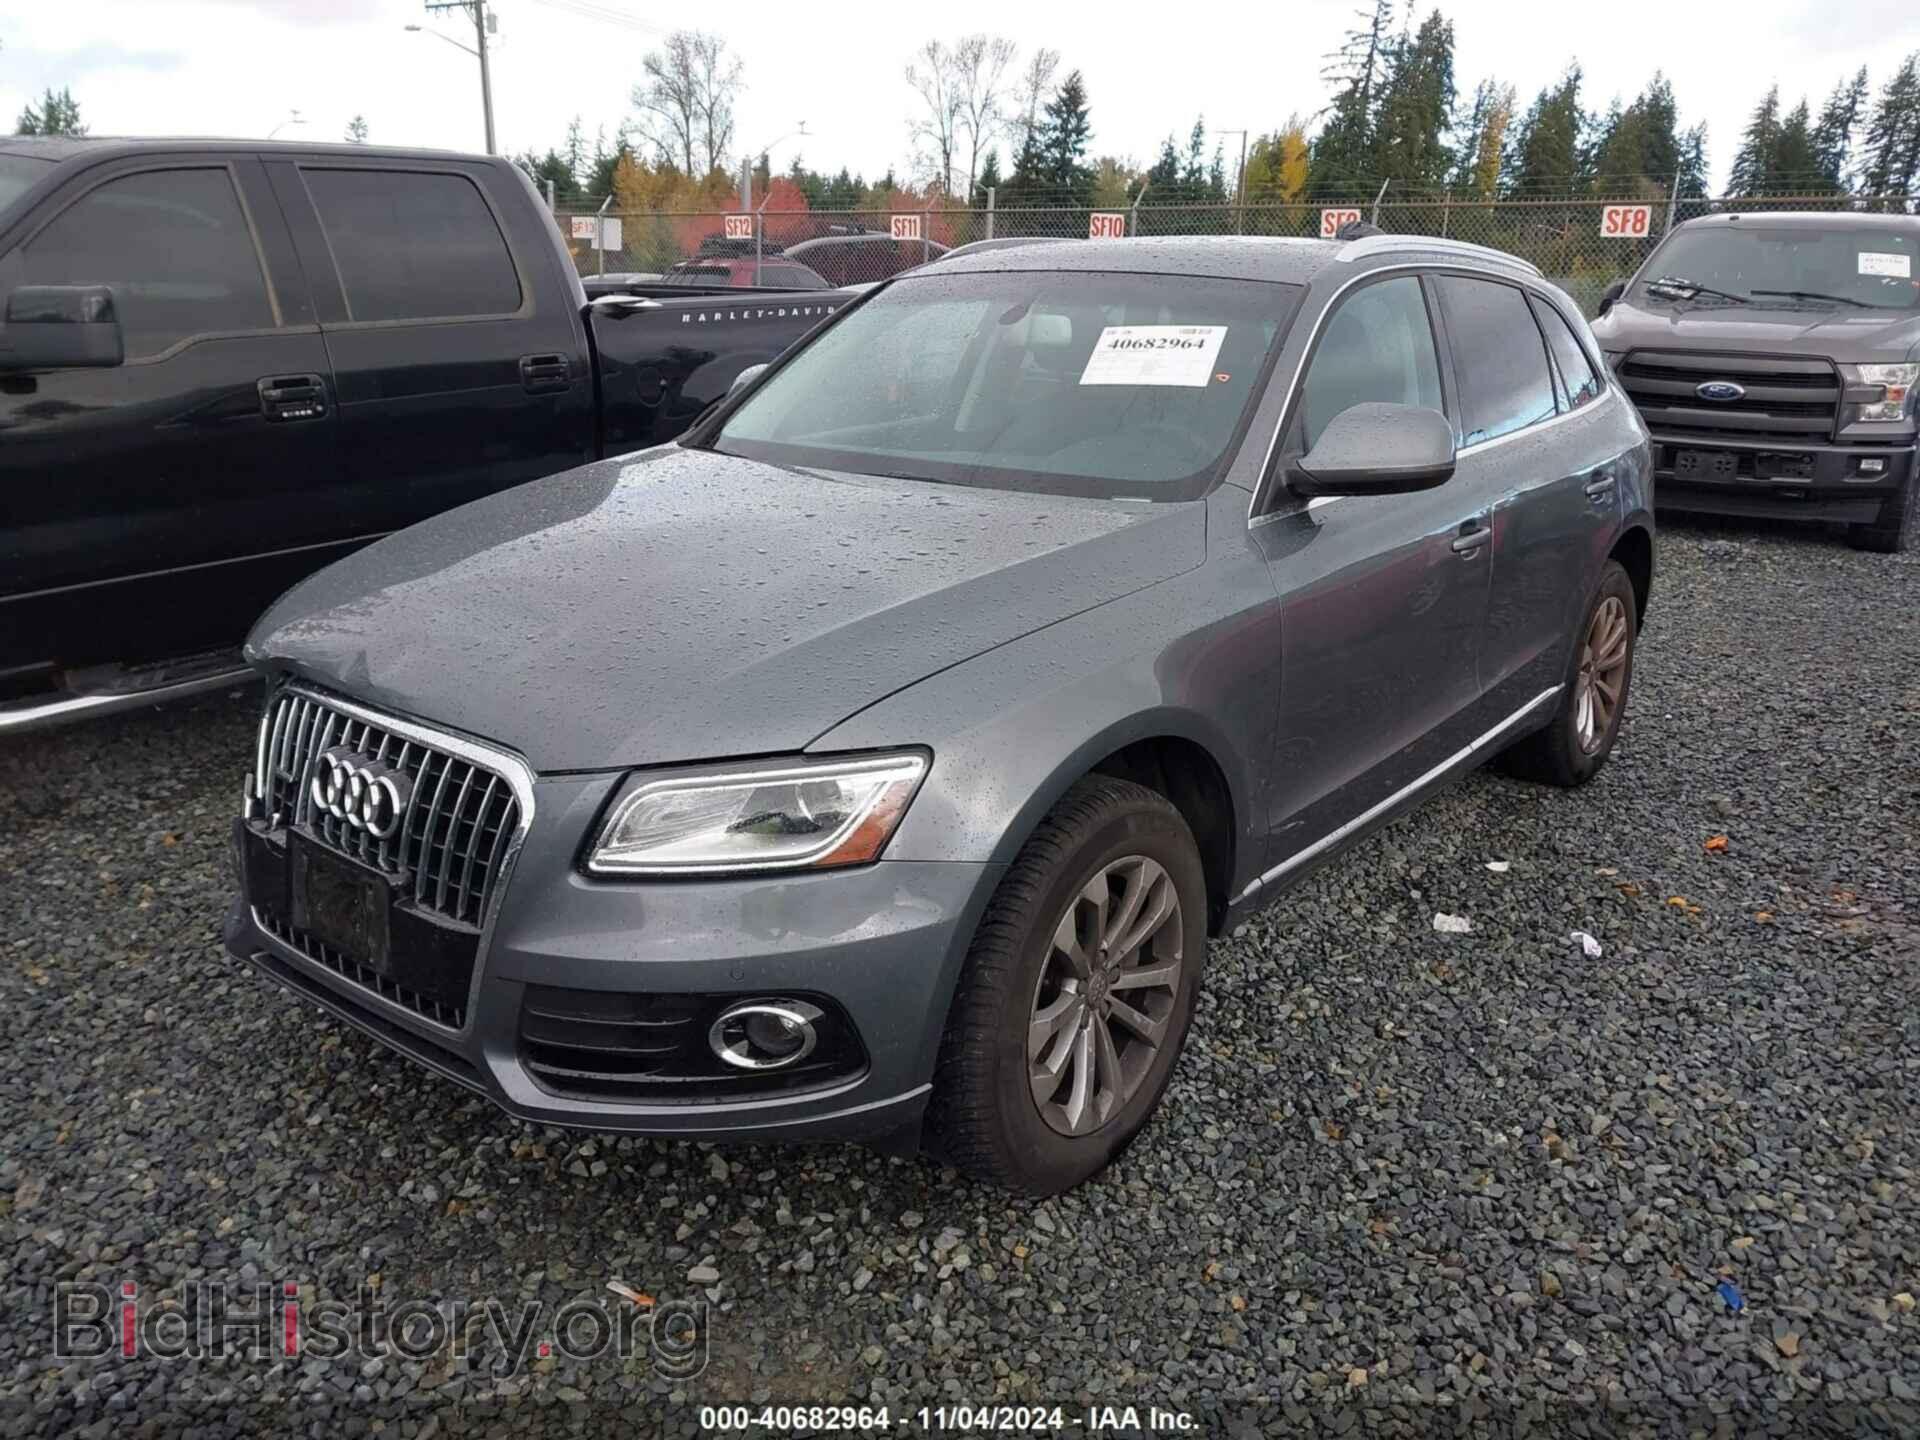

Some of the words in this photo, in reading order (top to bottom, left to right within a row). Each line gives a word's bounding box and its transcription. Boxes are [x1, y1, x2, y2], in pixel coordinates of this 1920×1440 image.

[727, 218, 751, 236] SF12
[894, 218, 917, 237] SF11
[1091, 216, 1123, 237] SF10
[1606, 208, 1647, 233] SF8
[1107, 337, 1206, 350] 40682964
